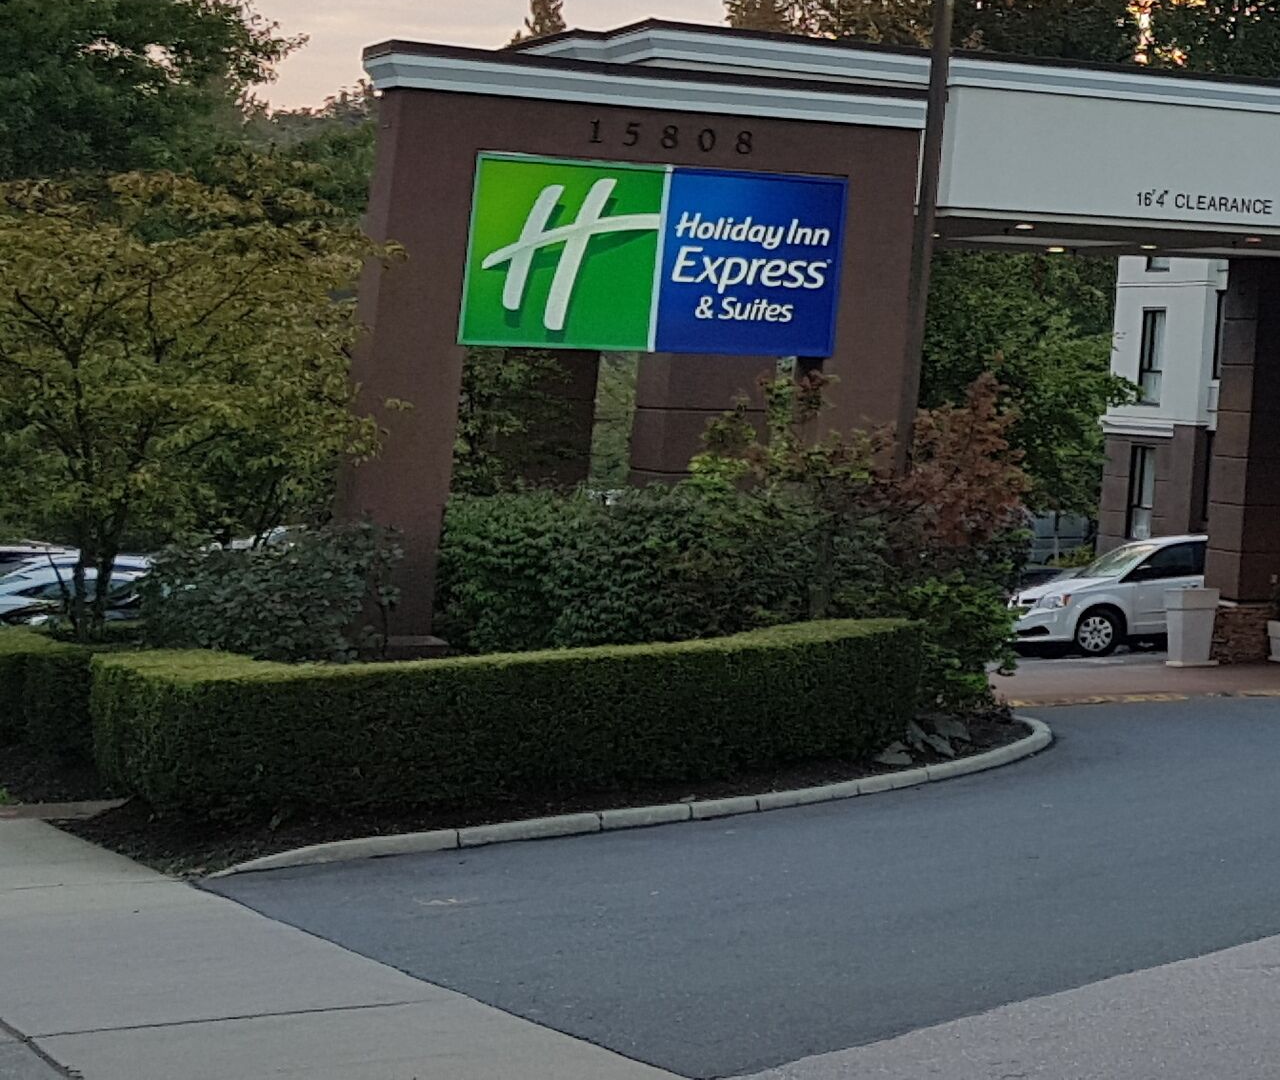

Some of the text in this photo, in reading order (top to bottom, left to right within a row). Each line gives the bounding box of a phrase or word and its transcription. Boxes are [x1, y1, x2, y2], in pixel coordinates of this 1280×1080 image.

[589, 119, 753, 155] 15808
[1174, 193, 1273, 215] CLEARANCE
[675, 211, 831, 250] Holiday Inn
[671, 245, 829, 294] Express
[694, 295, 794, 323] & Suites
